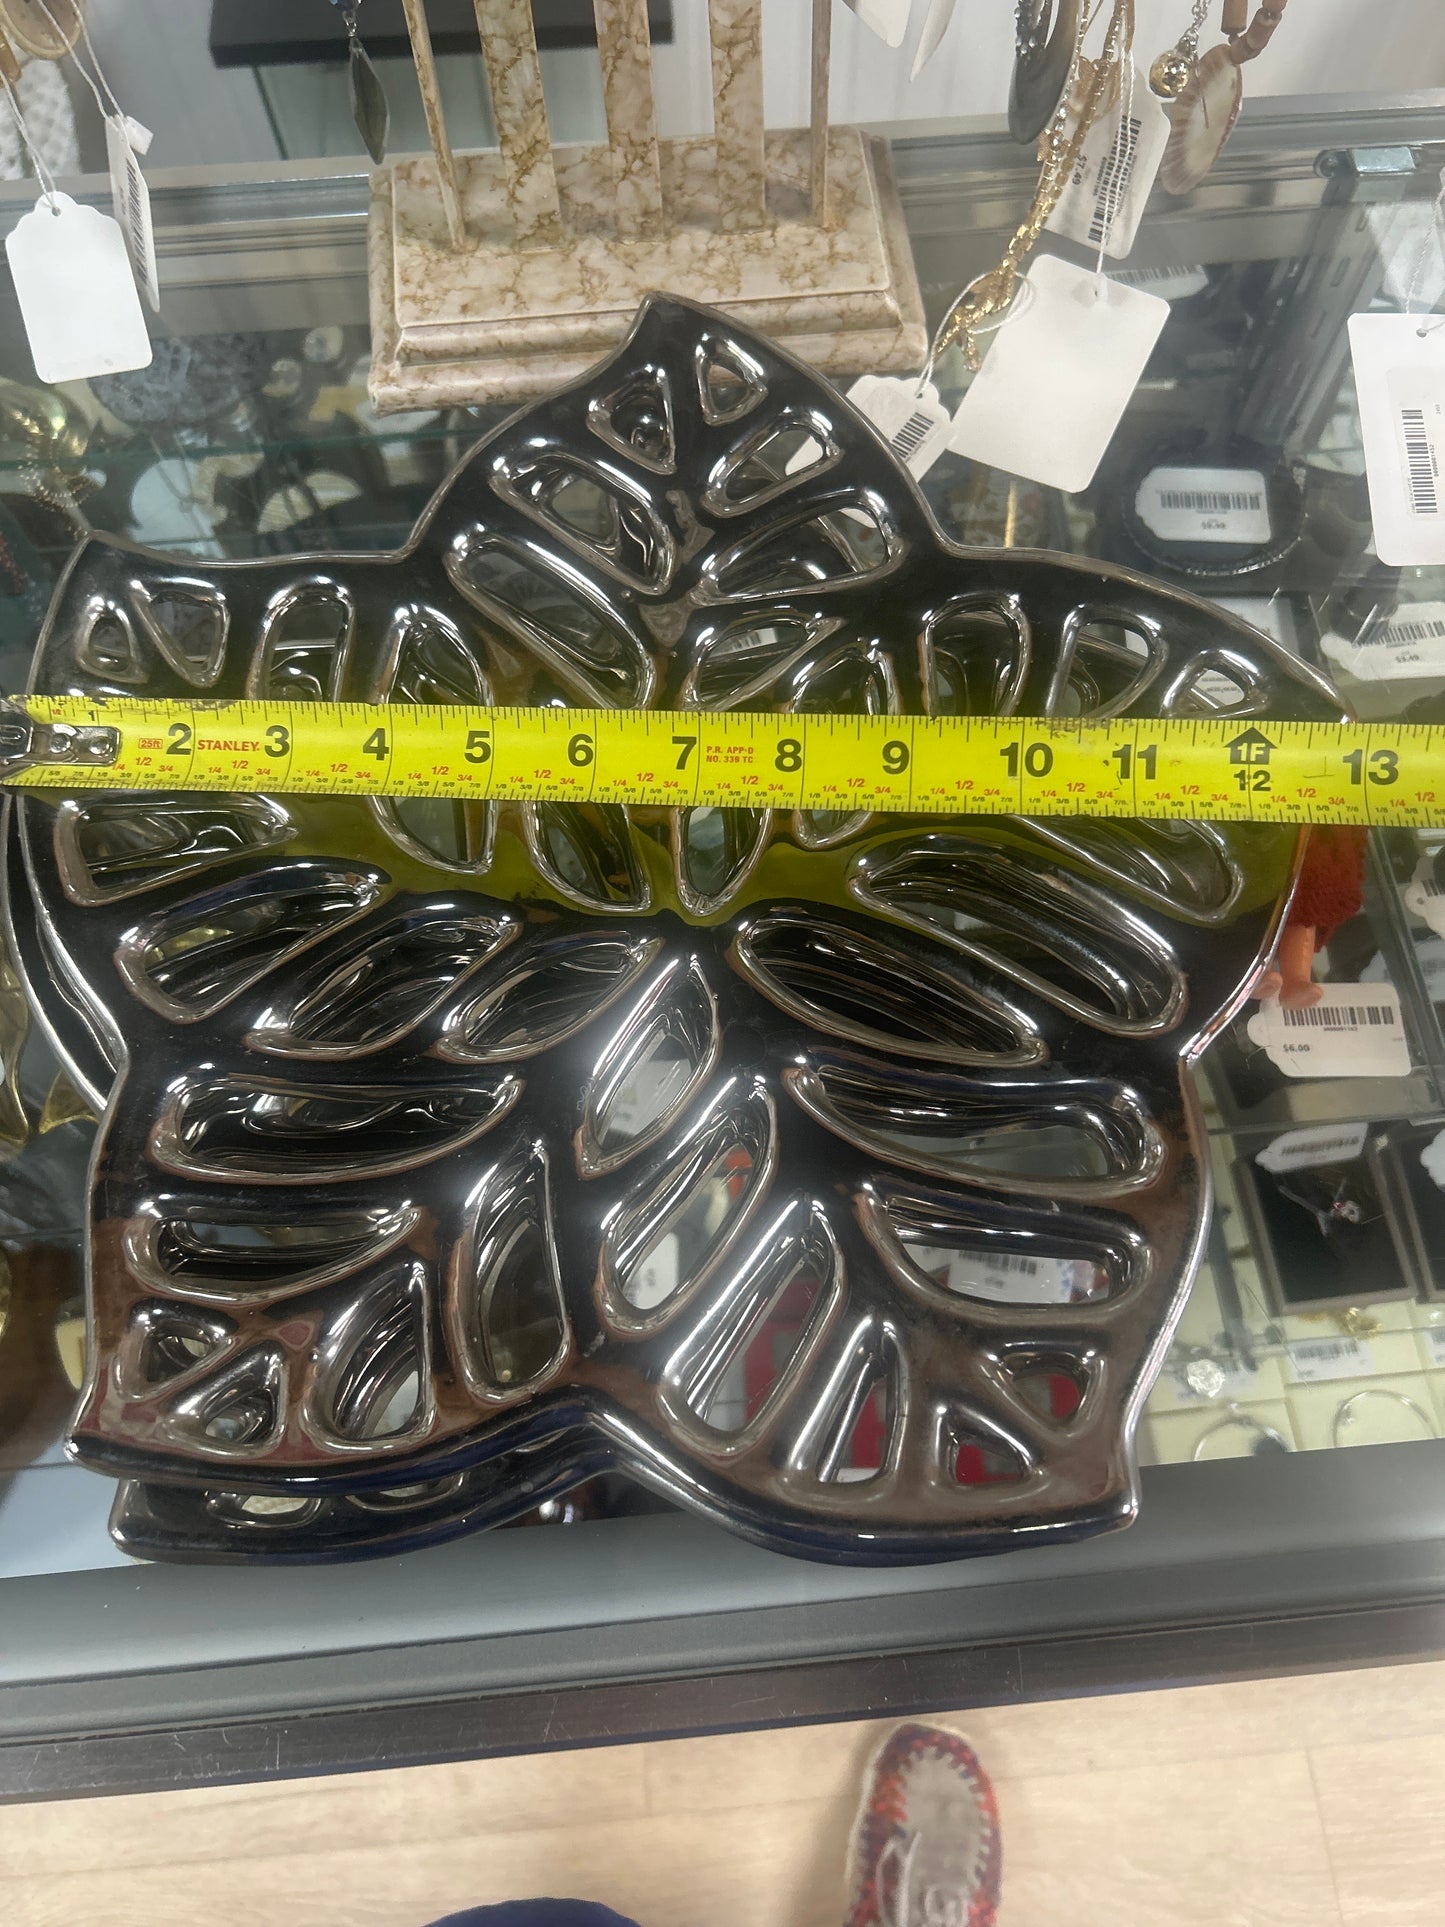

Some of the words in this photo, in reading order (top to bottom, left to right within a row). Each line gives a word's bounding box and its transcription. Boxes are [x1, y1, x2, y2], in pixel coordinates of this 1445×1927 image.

[1072, 155, 1088, 185] $7.49
[141, 740, 161, 748] 25ft
[198, 741, 258, 751] STANLEY
[707, 746, 722, 754] P.R.
[1237, 743, 1265, 762] 1F
[166, 723, 192, 755] 2
[264, 725, 290, 757] 3
[363, 728, 389, 761] 4
[464, 730, 491, 763] 5
[567, 734, 594, 767] 6
[672, 736, 697, 770] 7
[775, 739, 802, 772] 8
[882, 740, 909, 774] 9
[1000, 742, 1054, 777] 10
[1112, 744, 1158, 780] 11
[1343, 749, 1399, 785] 13
[136, 757, 152, 766] 1/2
[232, 760, 248, 769] 1/2
[330, 763, 347, 773] 1/2
[432, 766, 449, 775] 1/2
[534, 770, 551, 778] 1/2
[637, 772, 654, 782] 1/2
[716, 782, 731, 790] 1/4
[741, 776, 758, 785] 1/2
[847, 778, 865, 787] 1/2
[875, 786, 891, 794] 3/4
[955, 780, 973, 790] 1/2
[1067, 783, 1085, 792] 1/2
[1154, 792, 1170, 800] 1/4
[1181, 785, 1200, 795] 1/2
[1270, 795, 1286, 803] 1/4
[1297, 788, 1316, 798] 1/2
[1389, 799, 1406, 807] 1/4
[1415, 792, 1435, 802] 1/2
[1234, 770, 1271, 791] 12
[1283, 1044, 1311, 1053] $6.00
